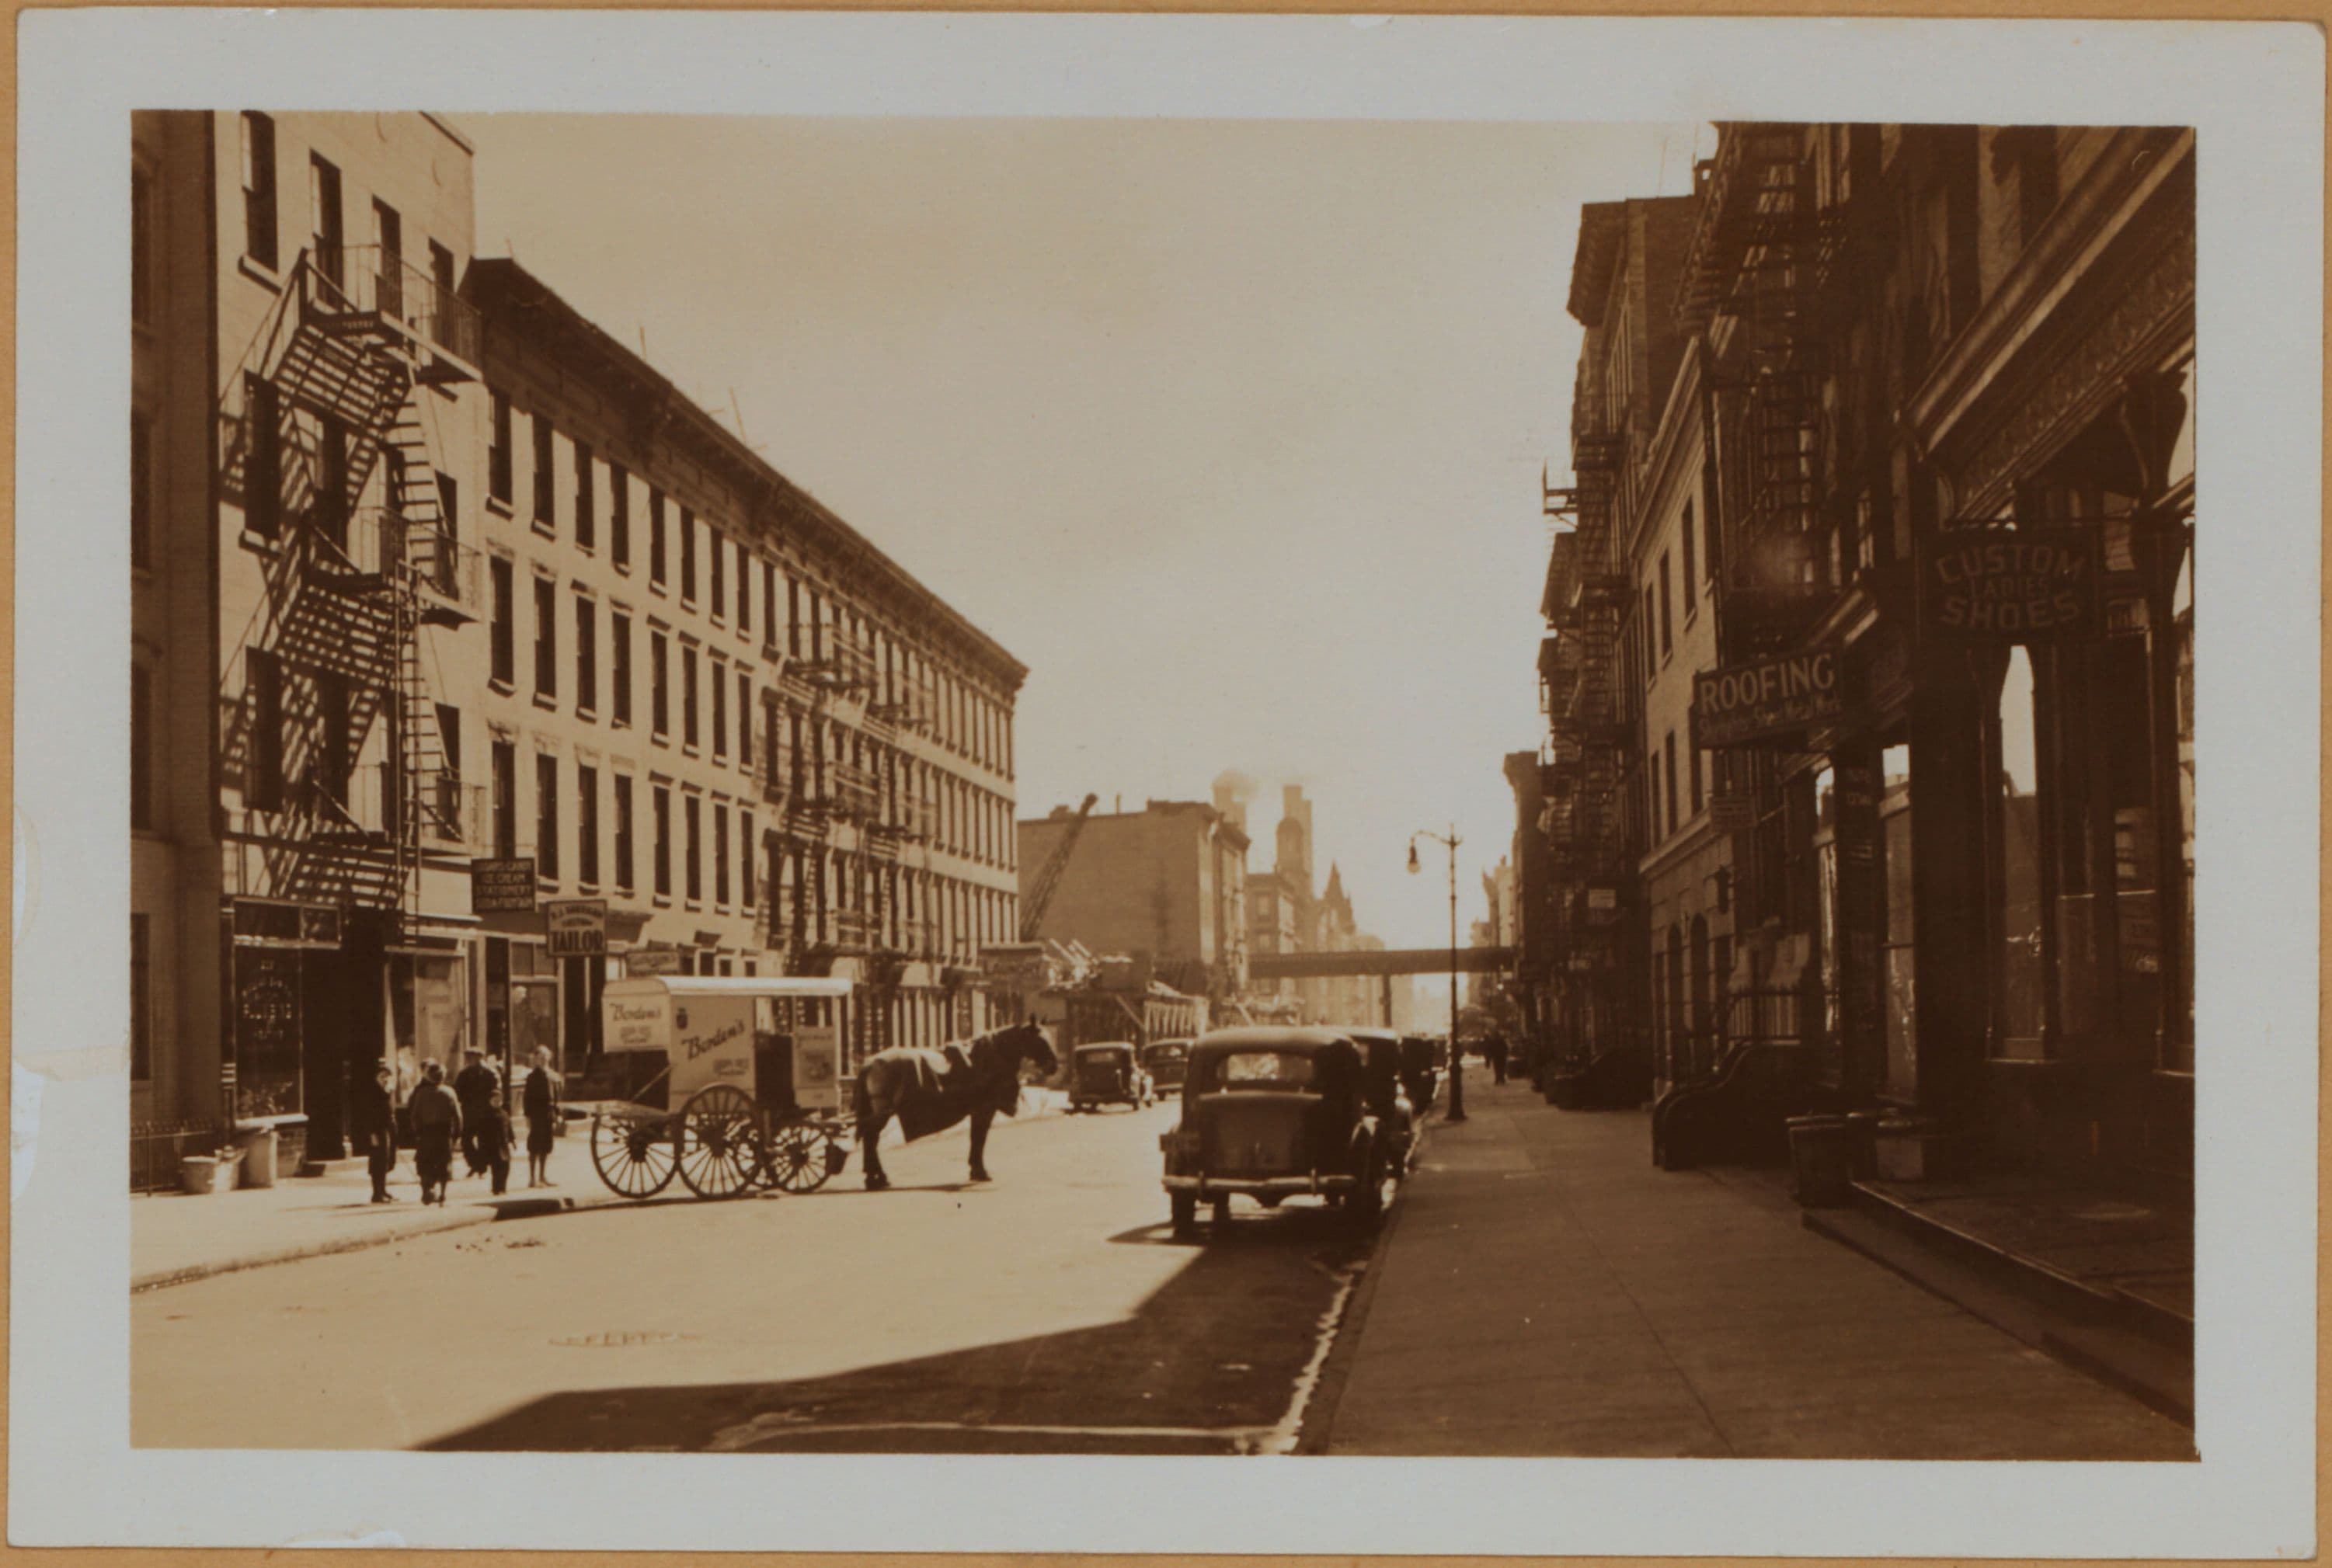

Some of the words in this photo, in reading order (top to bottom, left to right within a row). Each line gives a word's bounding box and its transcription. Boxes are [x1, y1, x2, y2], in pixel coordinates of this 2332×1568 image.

[1935, 544, 2086, 585] CUSTOM
[1968, 576, 2051, 597] LADIES
[1937, 590, 2081, 630] SHOES
[1699, 652, 1835, 714] ROOFING
[551, 930, 604, 952] TAILOR
[680, 1018, 745, 1061] Borden's
